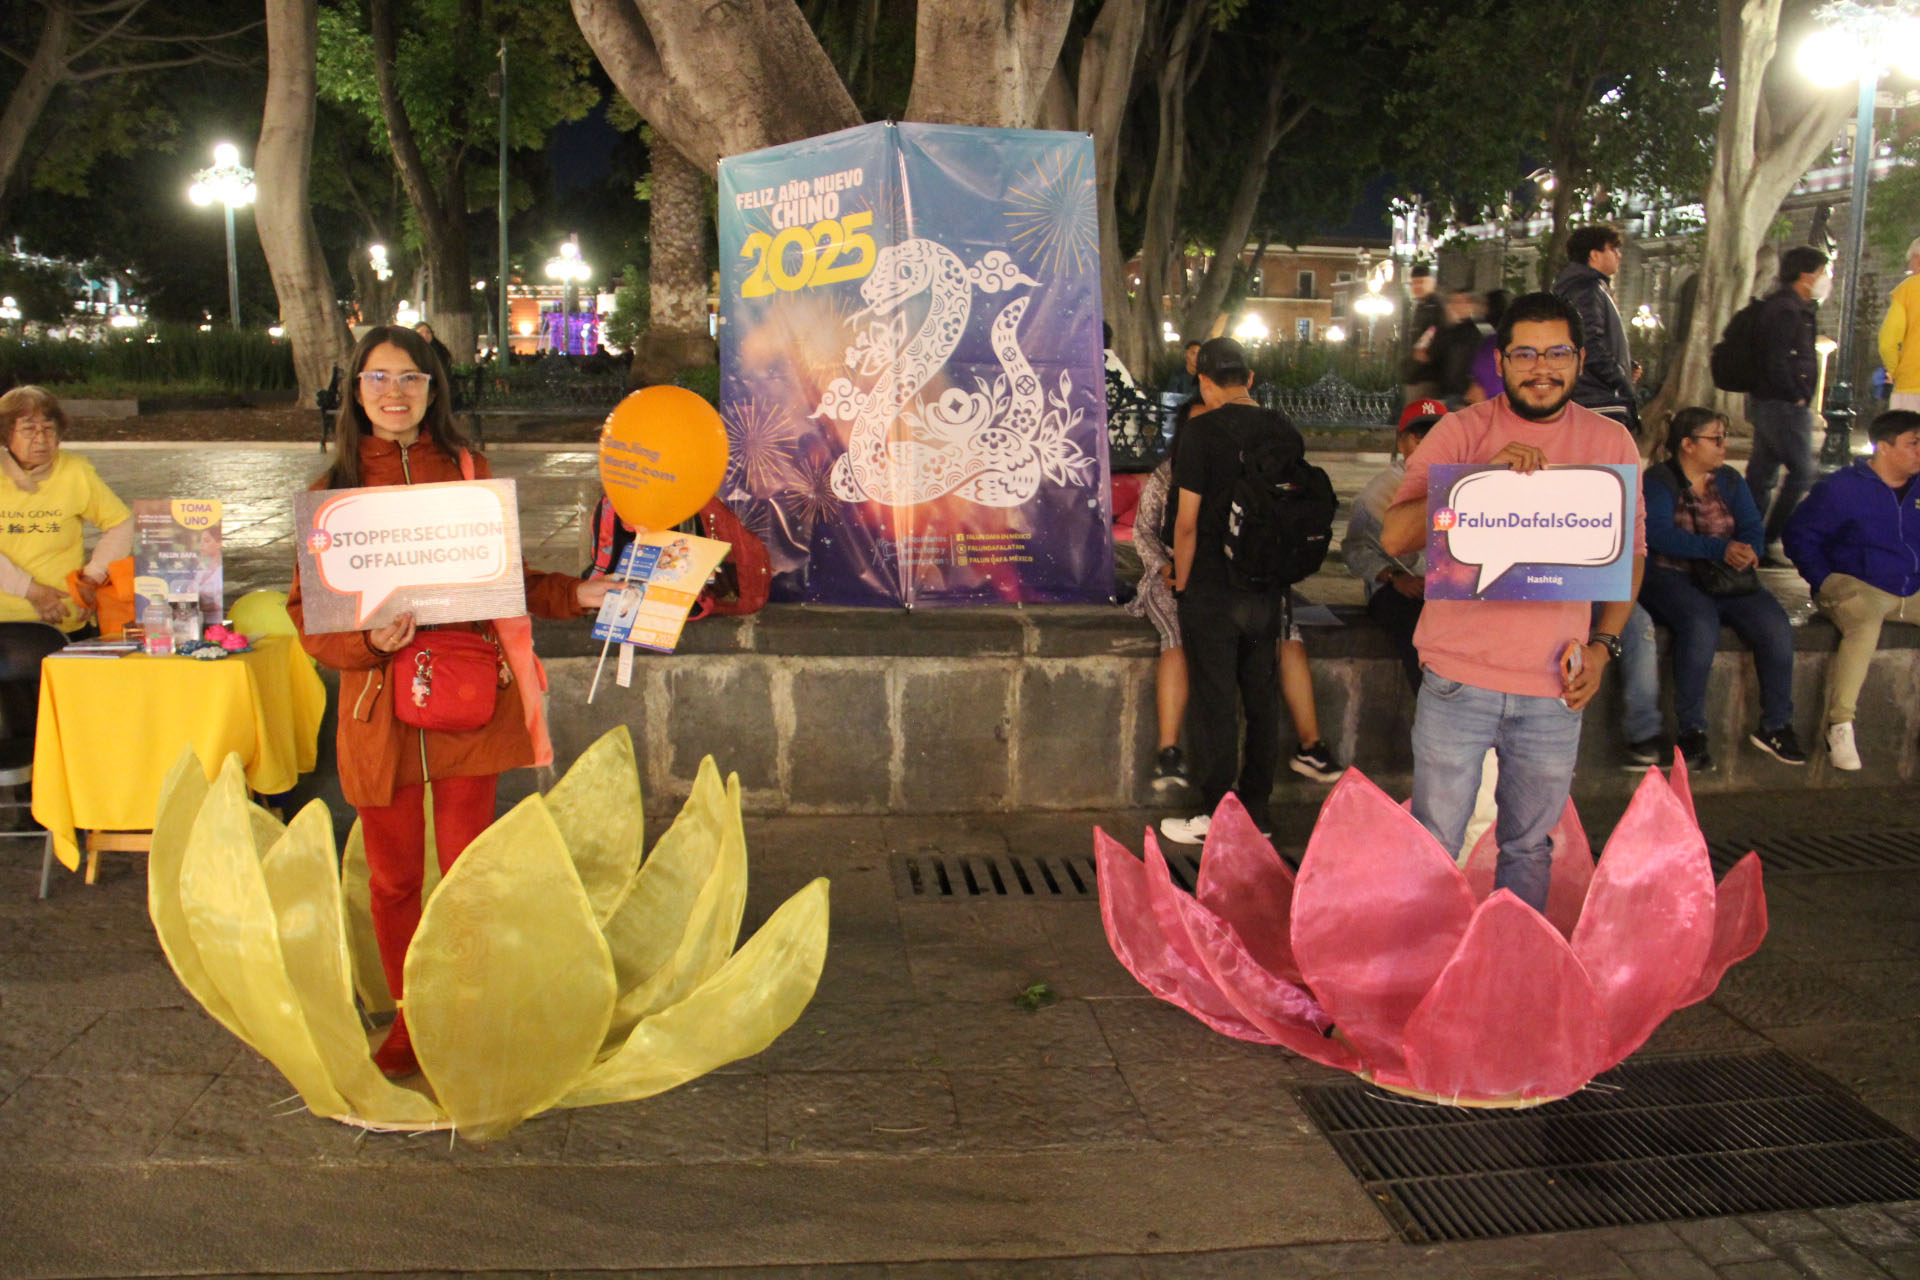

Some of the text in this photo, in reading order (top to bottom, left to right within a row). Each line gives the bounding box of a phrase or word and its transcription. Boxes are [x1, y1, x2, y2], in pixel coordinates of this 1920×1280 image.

[736, 168, 863, 210] FELIZ AÑO NUEVO
[771, 192, 839, 229] CHINO
[739, 210, 876, 298] 2025
[0, 509, 62, 518] LUN GONG
[181, 503, 212, 512] TOMA
[184, 516, 209, 525] UNO
[0, 521, 61, 534] 輪大法
[350, 545, 489, 569] OFFALUNGONG
[1526, 575, 1563, 585] Hashtag
